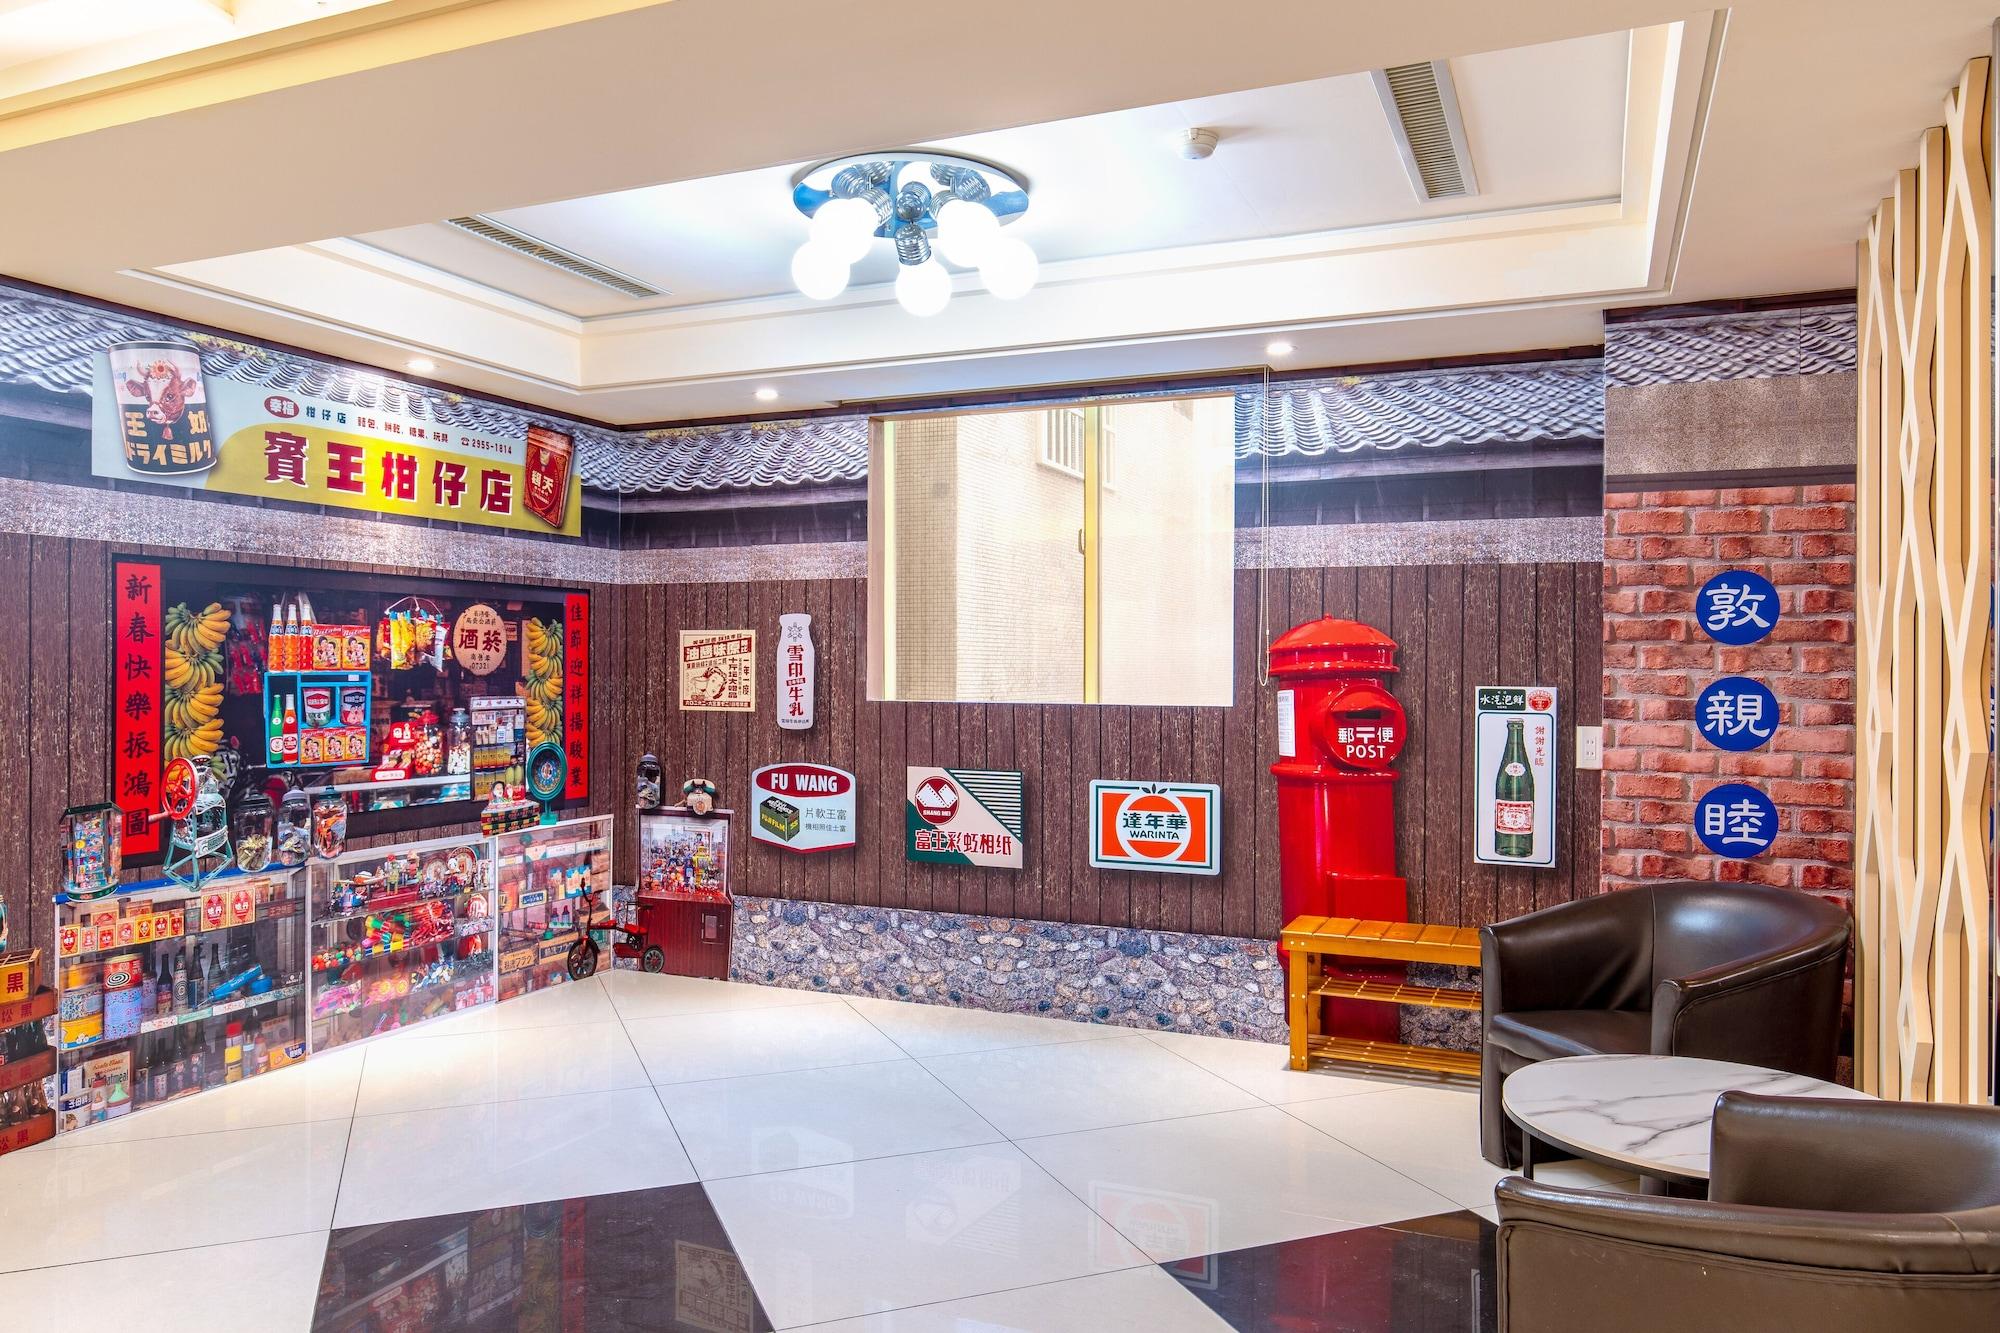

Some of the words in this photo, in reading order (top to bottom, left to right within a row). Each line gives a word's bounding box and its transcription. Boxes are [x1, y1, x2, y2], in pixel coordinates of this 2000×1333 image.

[306, 405, 347, 424] 柑仔店
[124, 574, 154, 837] 新春快樂振鴻圖
[1346, 744, 1386, 759] POST
[771, 773, 788, 790] FU
[795, 774, 838, 792] WANG
[1129, 830, 1180, 840] WARINTA
[7, 971, 25, 994] 黑
